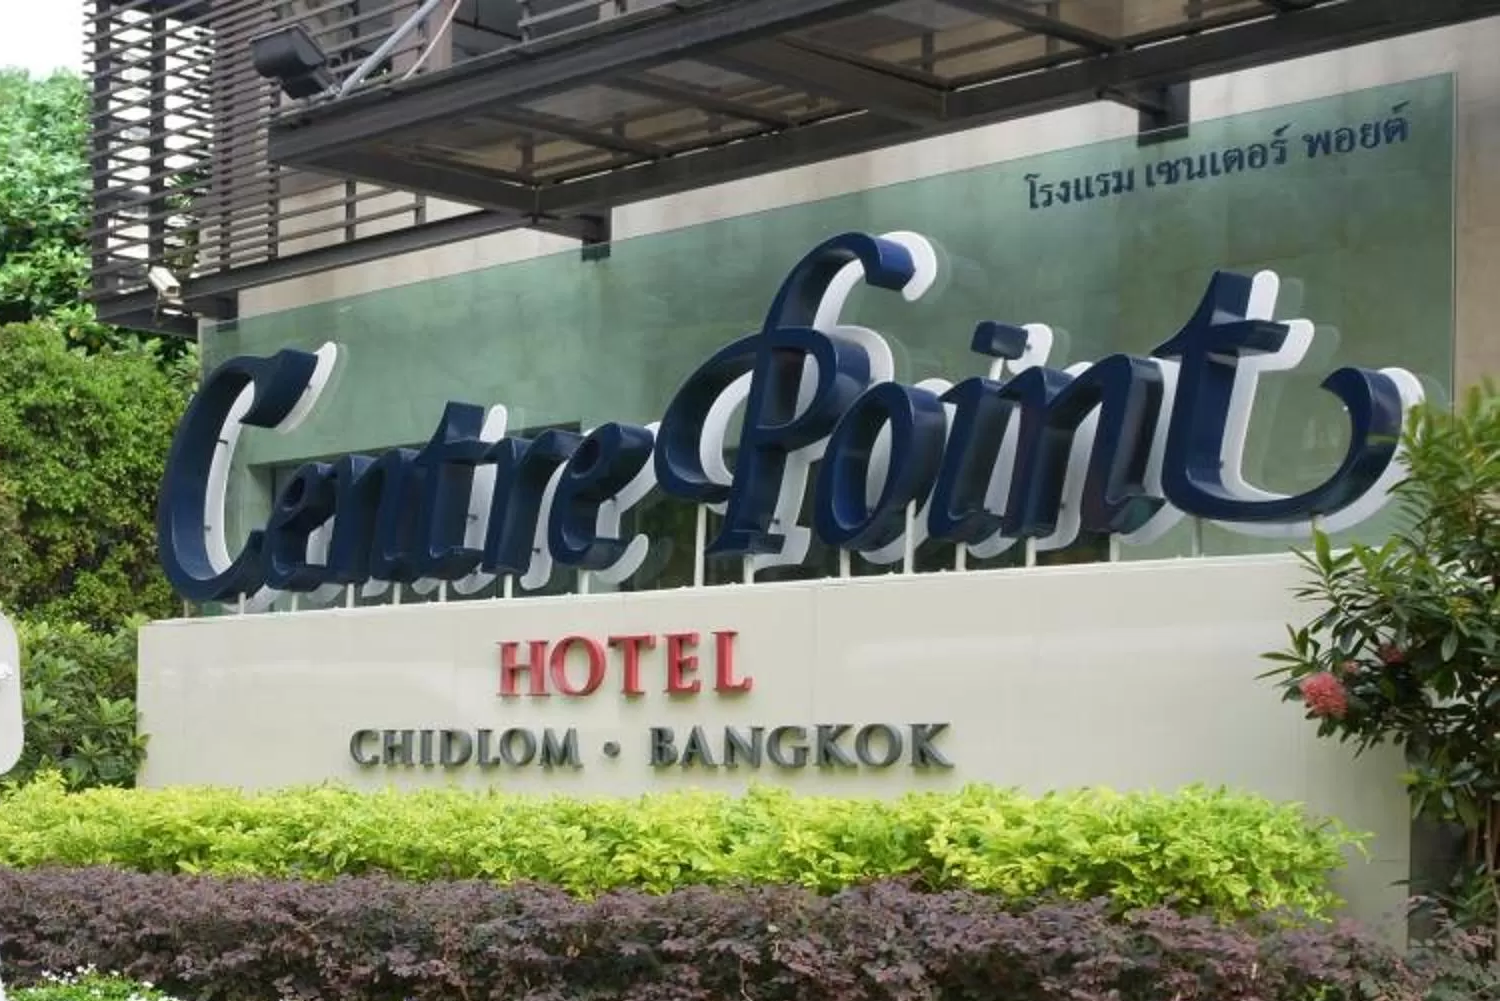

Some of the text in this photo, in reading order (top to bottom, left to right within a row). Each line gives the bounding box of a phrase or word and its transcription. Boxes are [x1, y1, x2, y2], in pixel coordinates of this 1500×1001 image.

[1024, 168, 1135, 209] โรงแรม
[158, 232, 1415, 602] Centre Point
[496, 629, 753, 698] HOTEL
[349, 722, 955, 771] CHIDLOM BANGKOK
